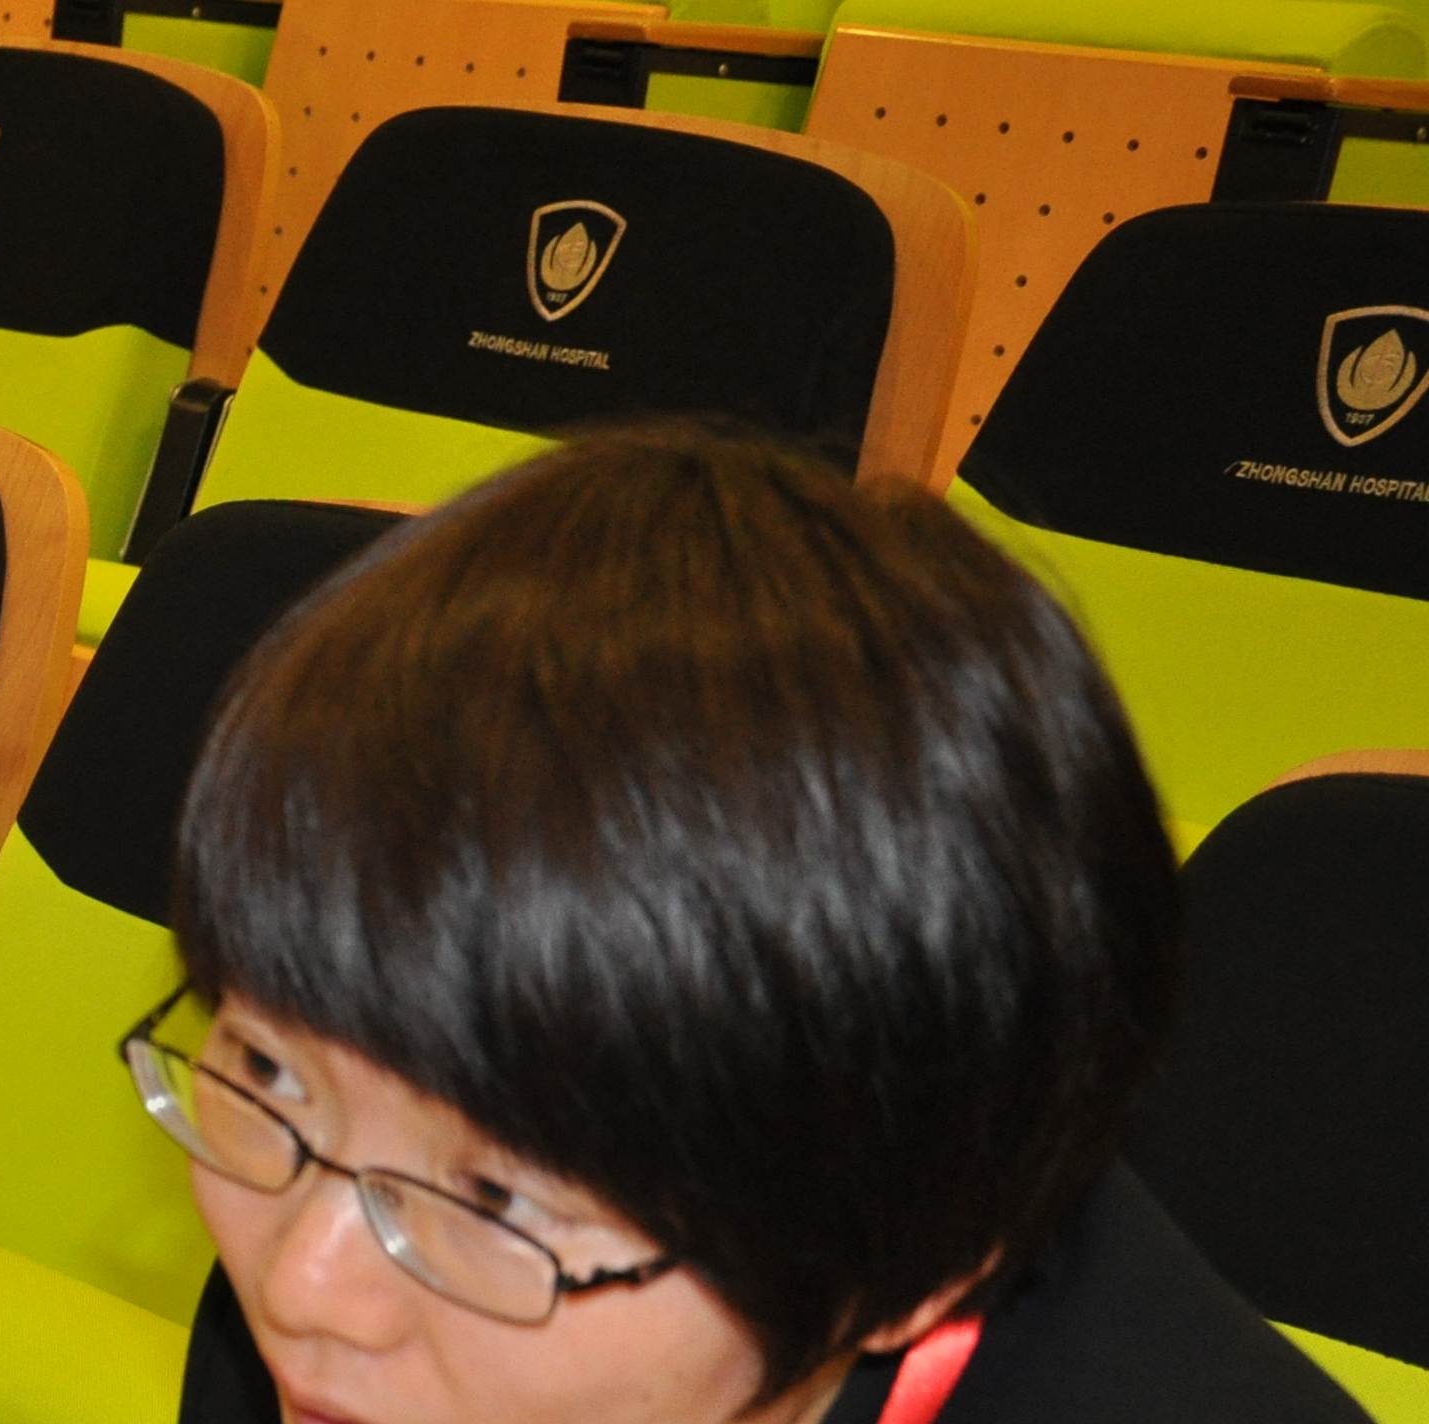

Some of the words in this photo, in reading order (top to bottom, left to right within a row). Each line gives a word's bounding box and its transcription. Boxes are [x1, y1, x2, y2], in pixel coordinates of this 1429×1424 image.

[468, 331, 548, 361] ZHONGSHAN
[550, 345, 610, 370] HOSPITAL
[1235, 460, 1346, 492] ZHONGSHAN
